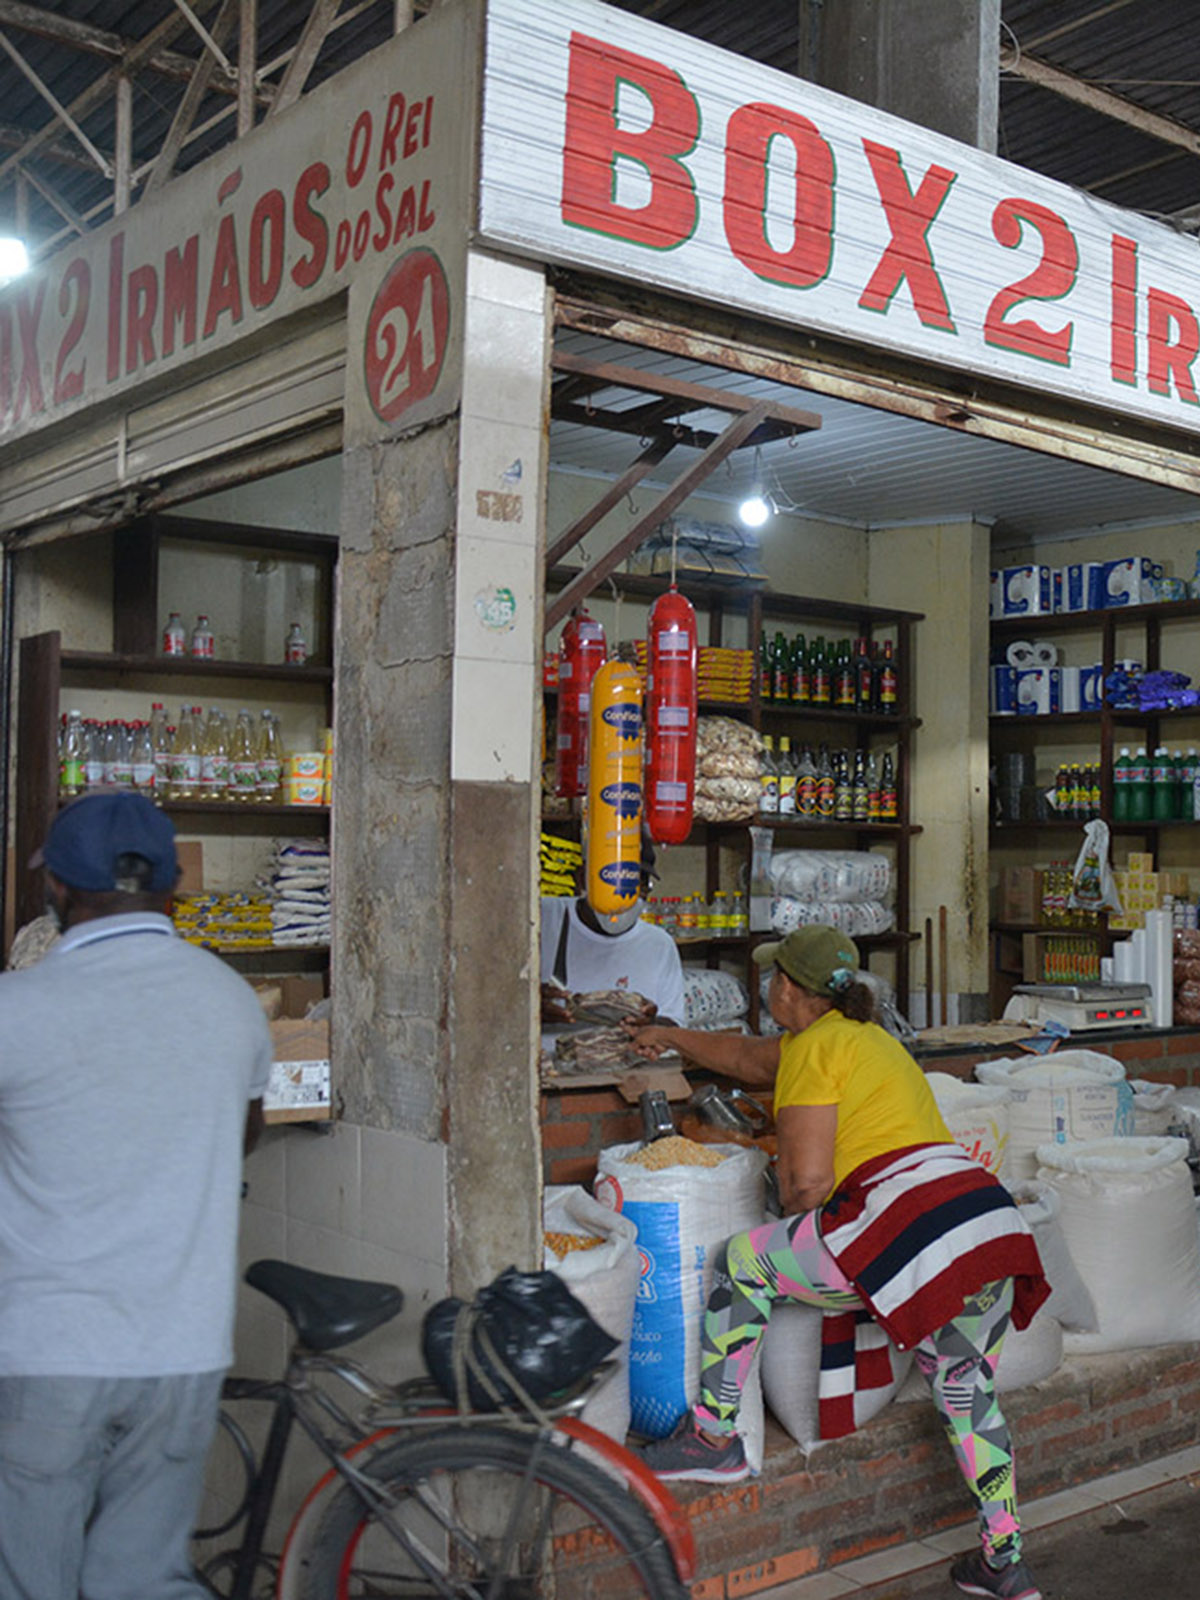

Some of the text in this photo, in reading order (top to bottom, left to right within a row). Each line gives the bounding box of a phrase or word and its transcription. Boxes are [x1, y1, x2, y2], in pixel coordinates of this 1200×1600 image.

[346, 92, 434, 188] O REI
[562, 31, 957, 334] BOX
[984, 198, 1079, 367] 2
[54, 257, 91, 404] 2
[107, 161, 330, 383] IRMÃOS
[335, 172, 435, 273] DO SAL
[376, 274, 435, 407] 21
